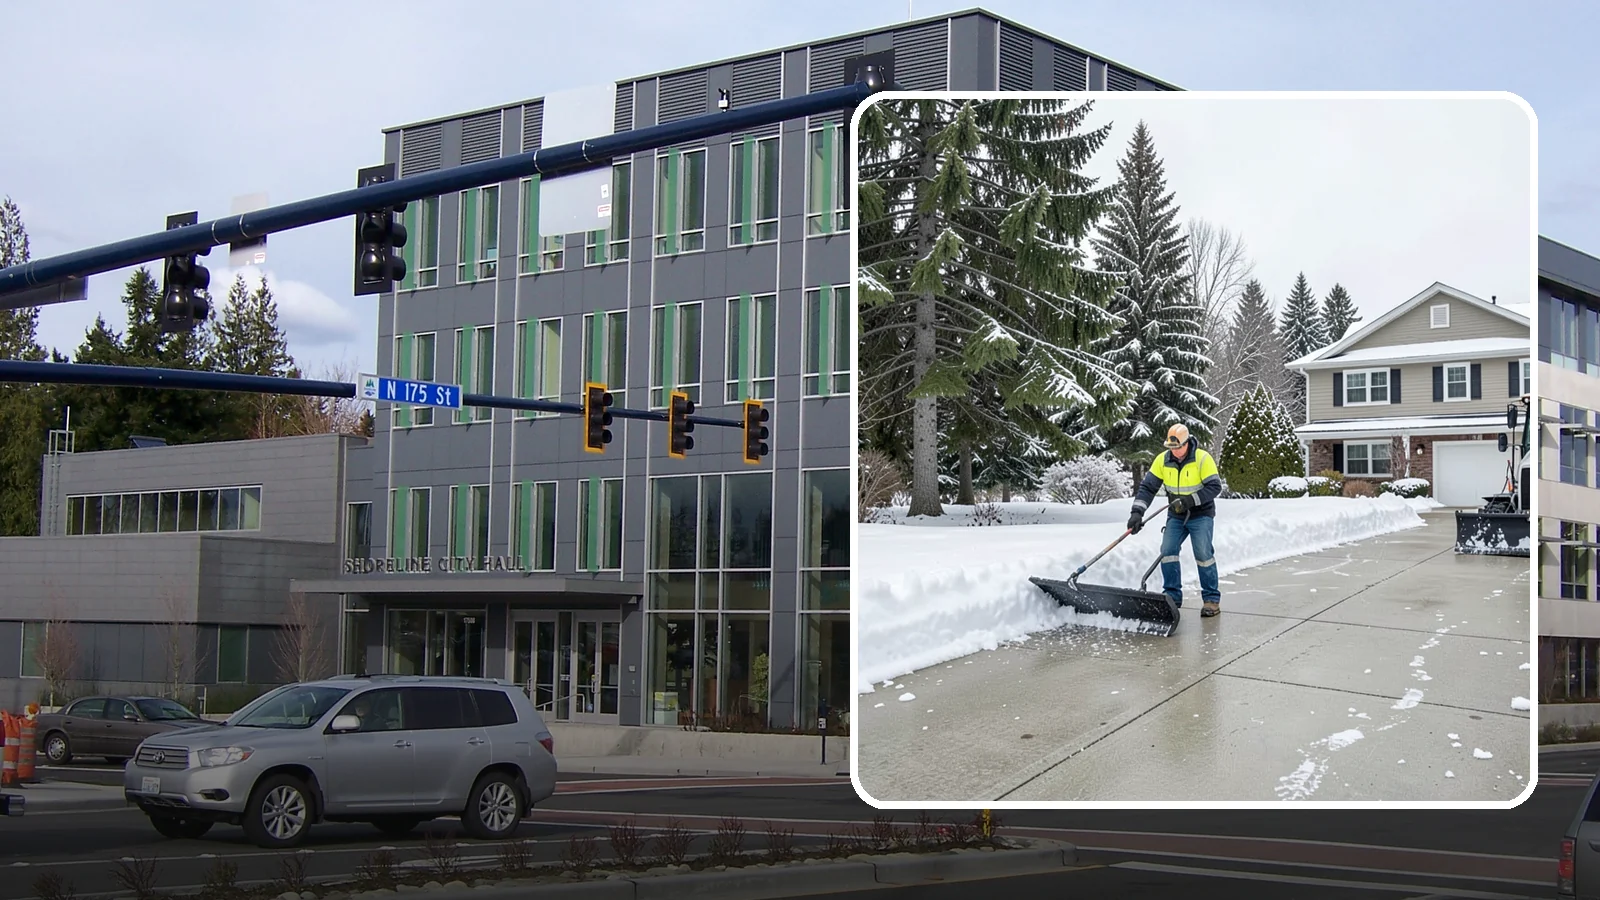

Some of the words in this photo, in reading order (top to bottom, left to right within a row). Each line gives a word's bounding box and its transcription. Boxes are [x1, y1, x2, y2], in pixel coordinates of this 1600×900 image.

[387, 380, 396, 400] N
[405, 382, 427, 403] 175
[436, 386, 451, 406] St
[344, 557, 432, 574] SHORELINE
[438, 556, 476, 573] CITY
[484, 555, 526, 572] HALL
